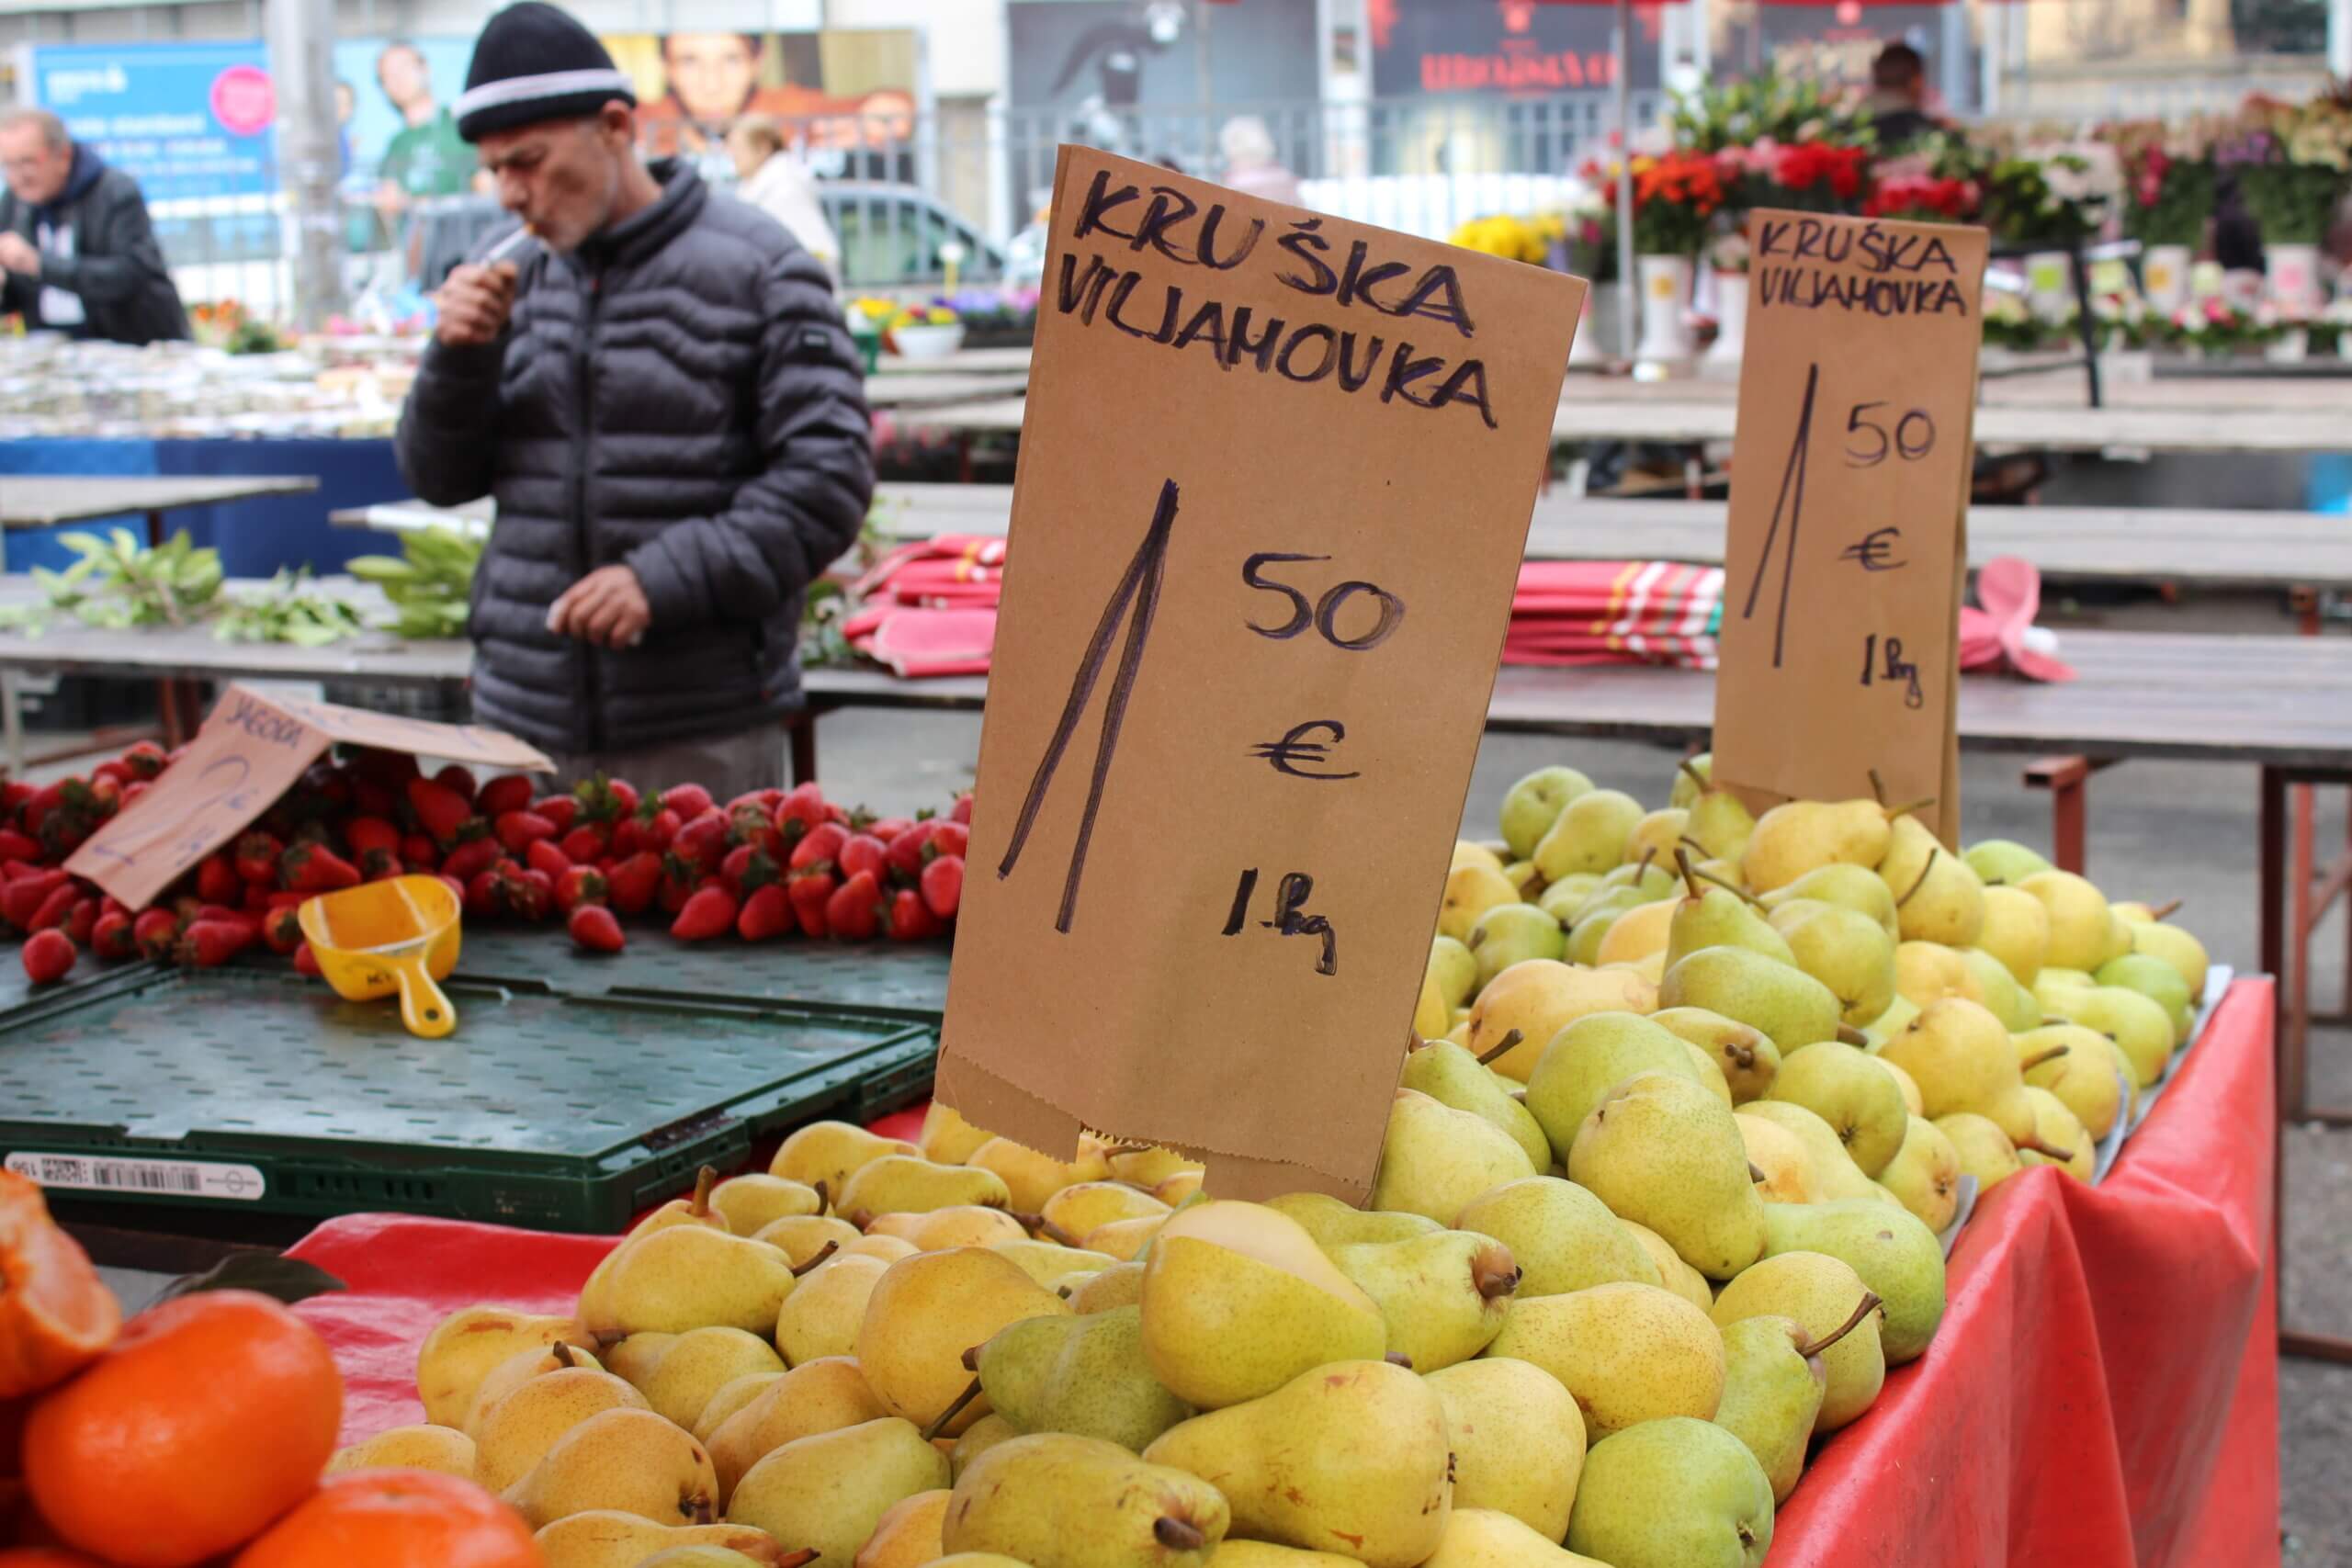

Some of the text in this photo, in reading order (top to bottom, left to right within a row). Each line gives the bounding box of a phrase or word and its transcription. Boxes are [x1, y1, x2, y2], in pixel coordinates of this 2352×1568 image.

[1073, 170, 1476, 338] KRUŠKA
[1758, 219, 1958, 274] KRUŠKA
[1843, 400, 1937, 469] 50
[1838, 526, 1909, 572] €
[1241, 551, 1407, 651] 50
[1244, 719, 1361, 780] €
